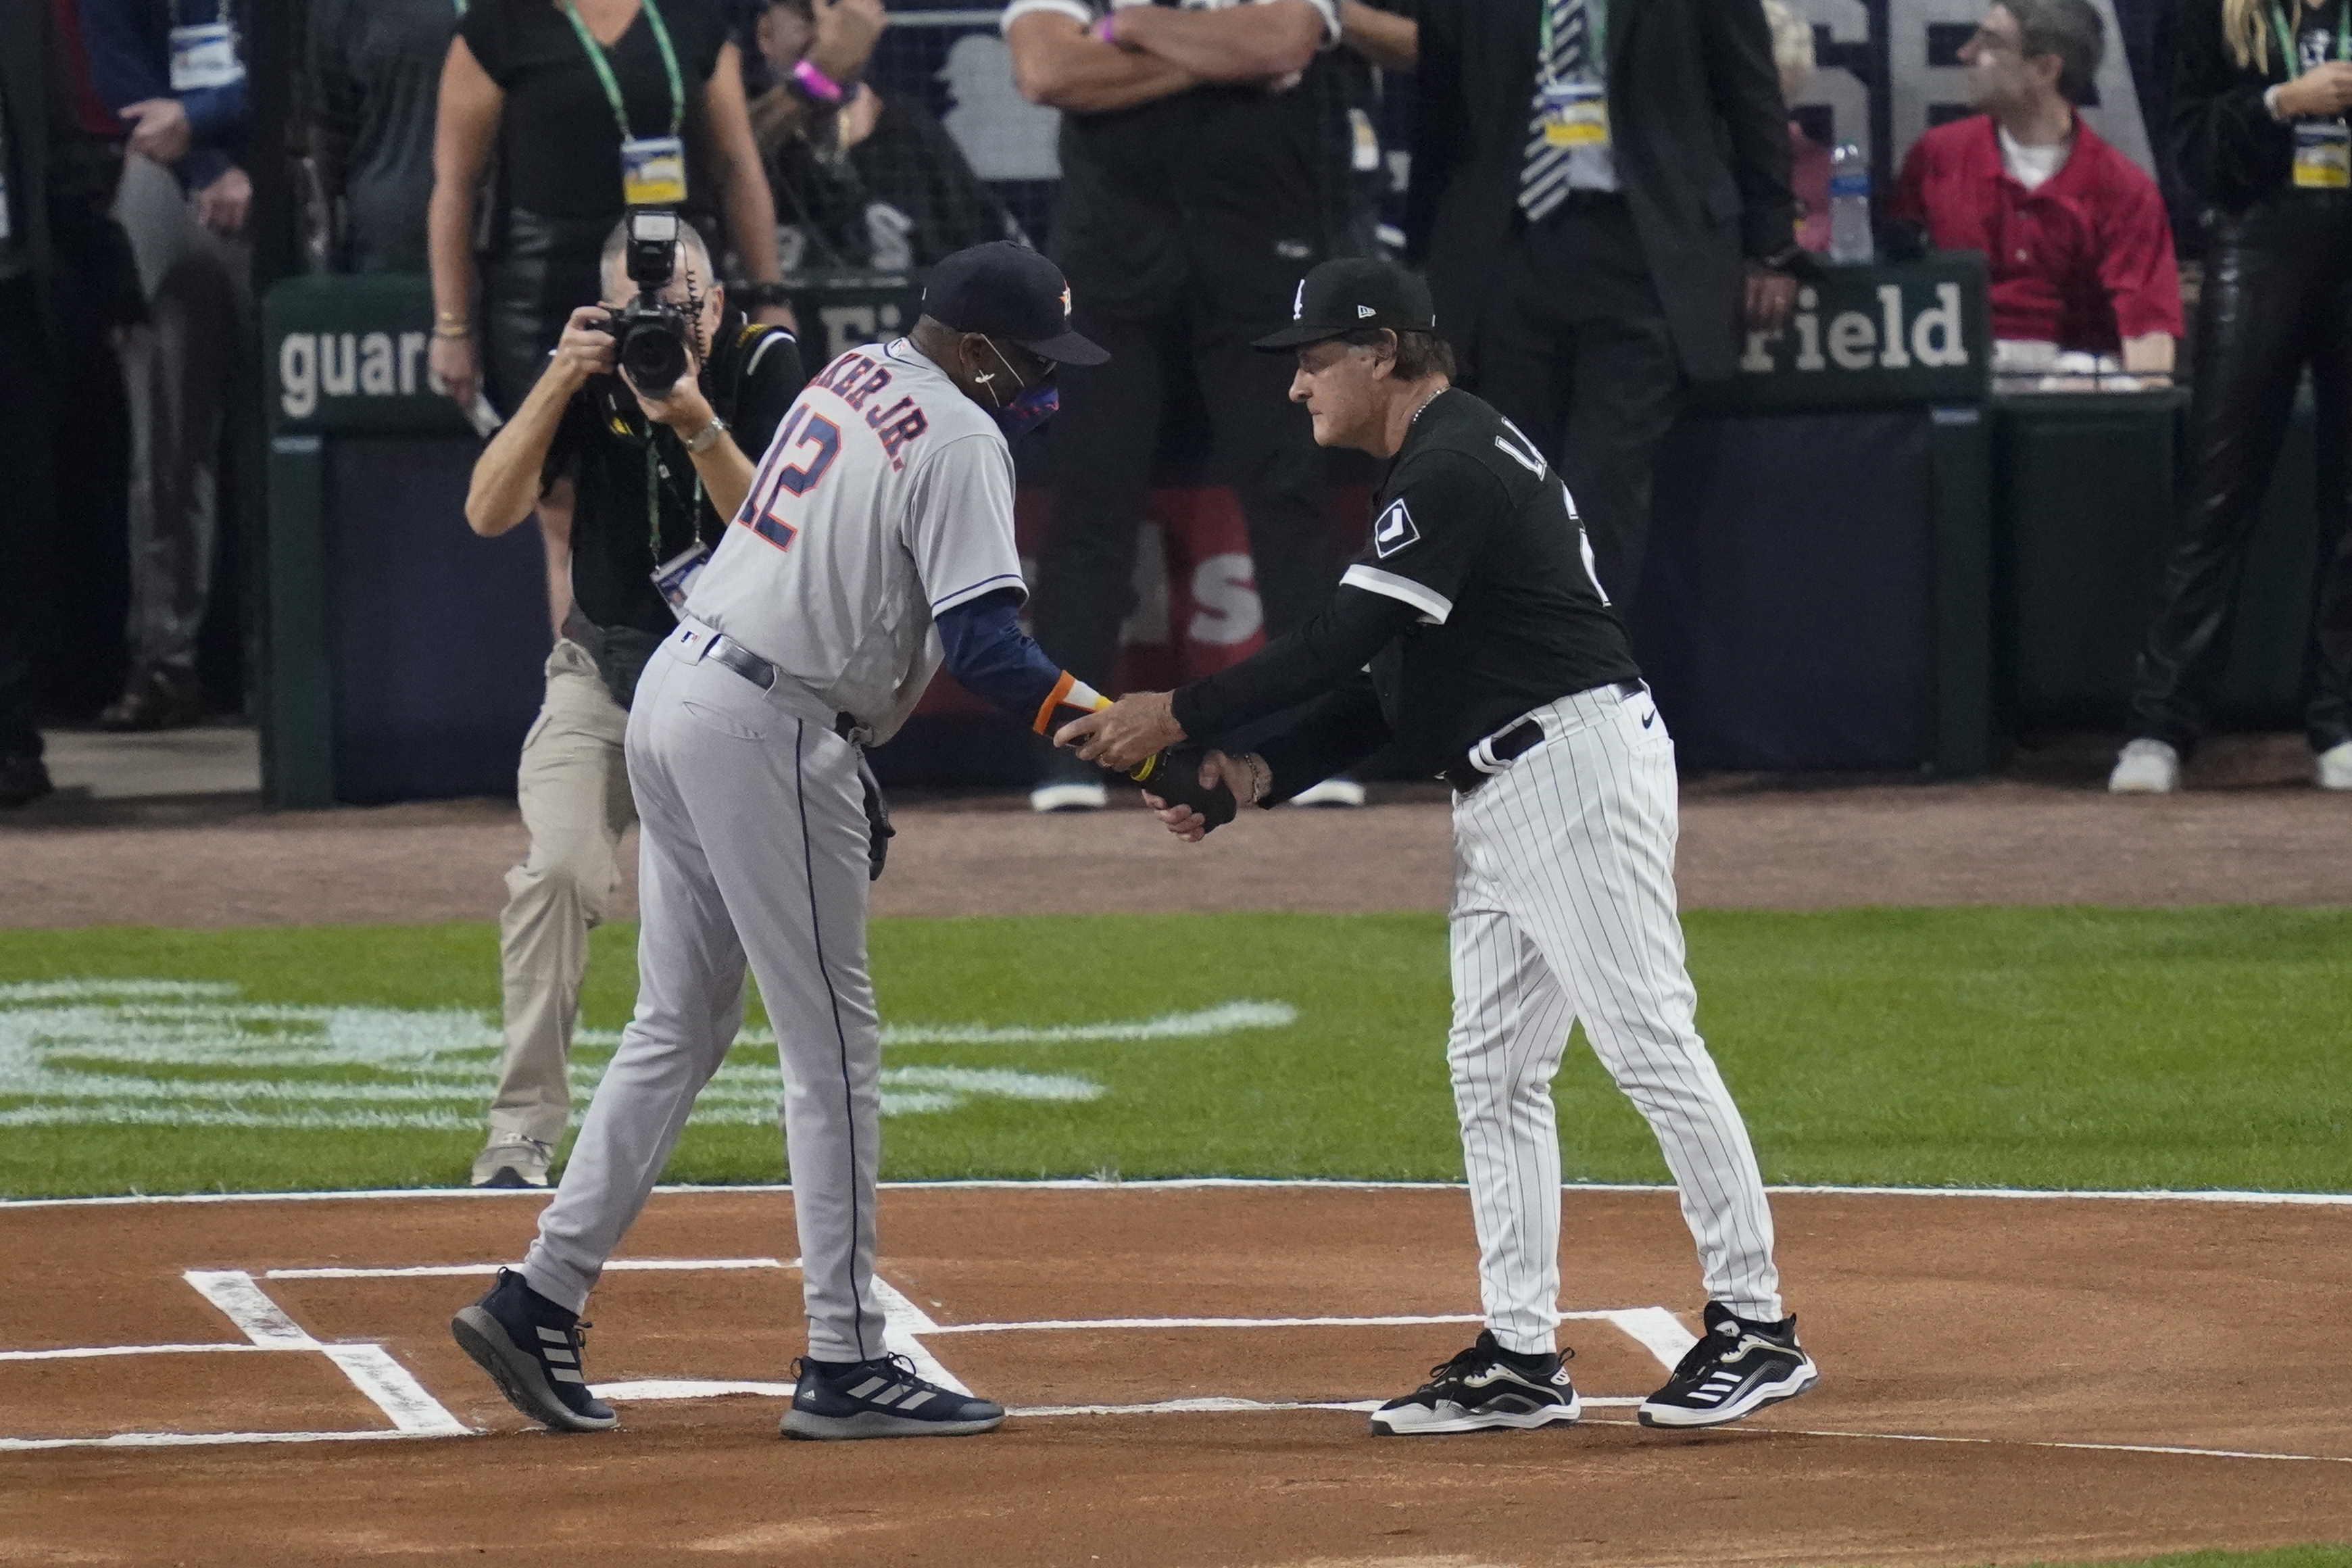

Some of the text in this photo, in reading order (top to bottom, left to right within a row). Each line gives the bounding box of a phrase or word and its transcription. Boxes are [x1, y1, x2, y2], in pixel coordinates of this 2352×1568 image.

[278, 330, 449, 418] guar
[737, 401, 842, 553] 12
[864, 395, 929, 472] JR.
